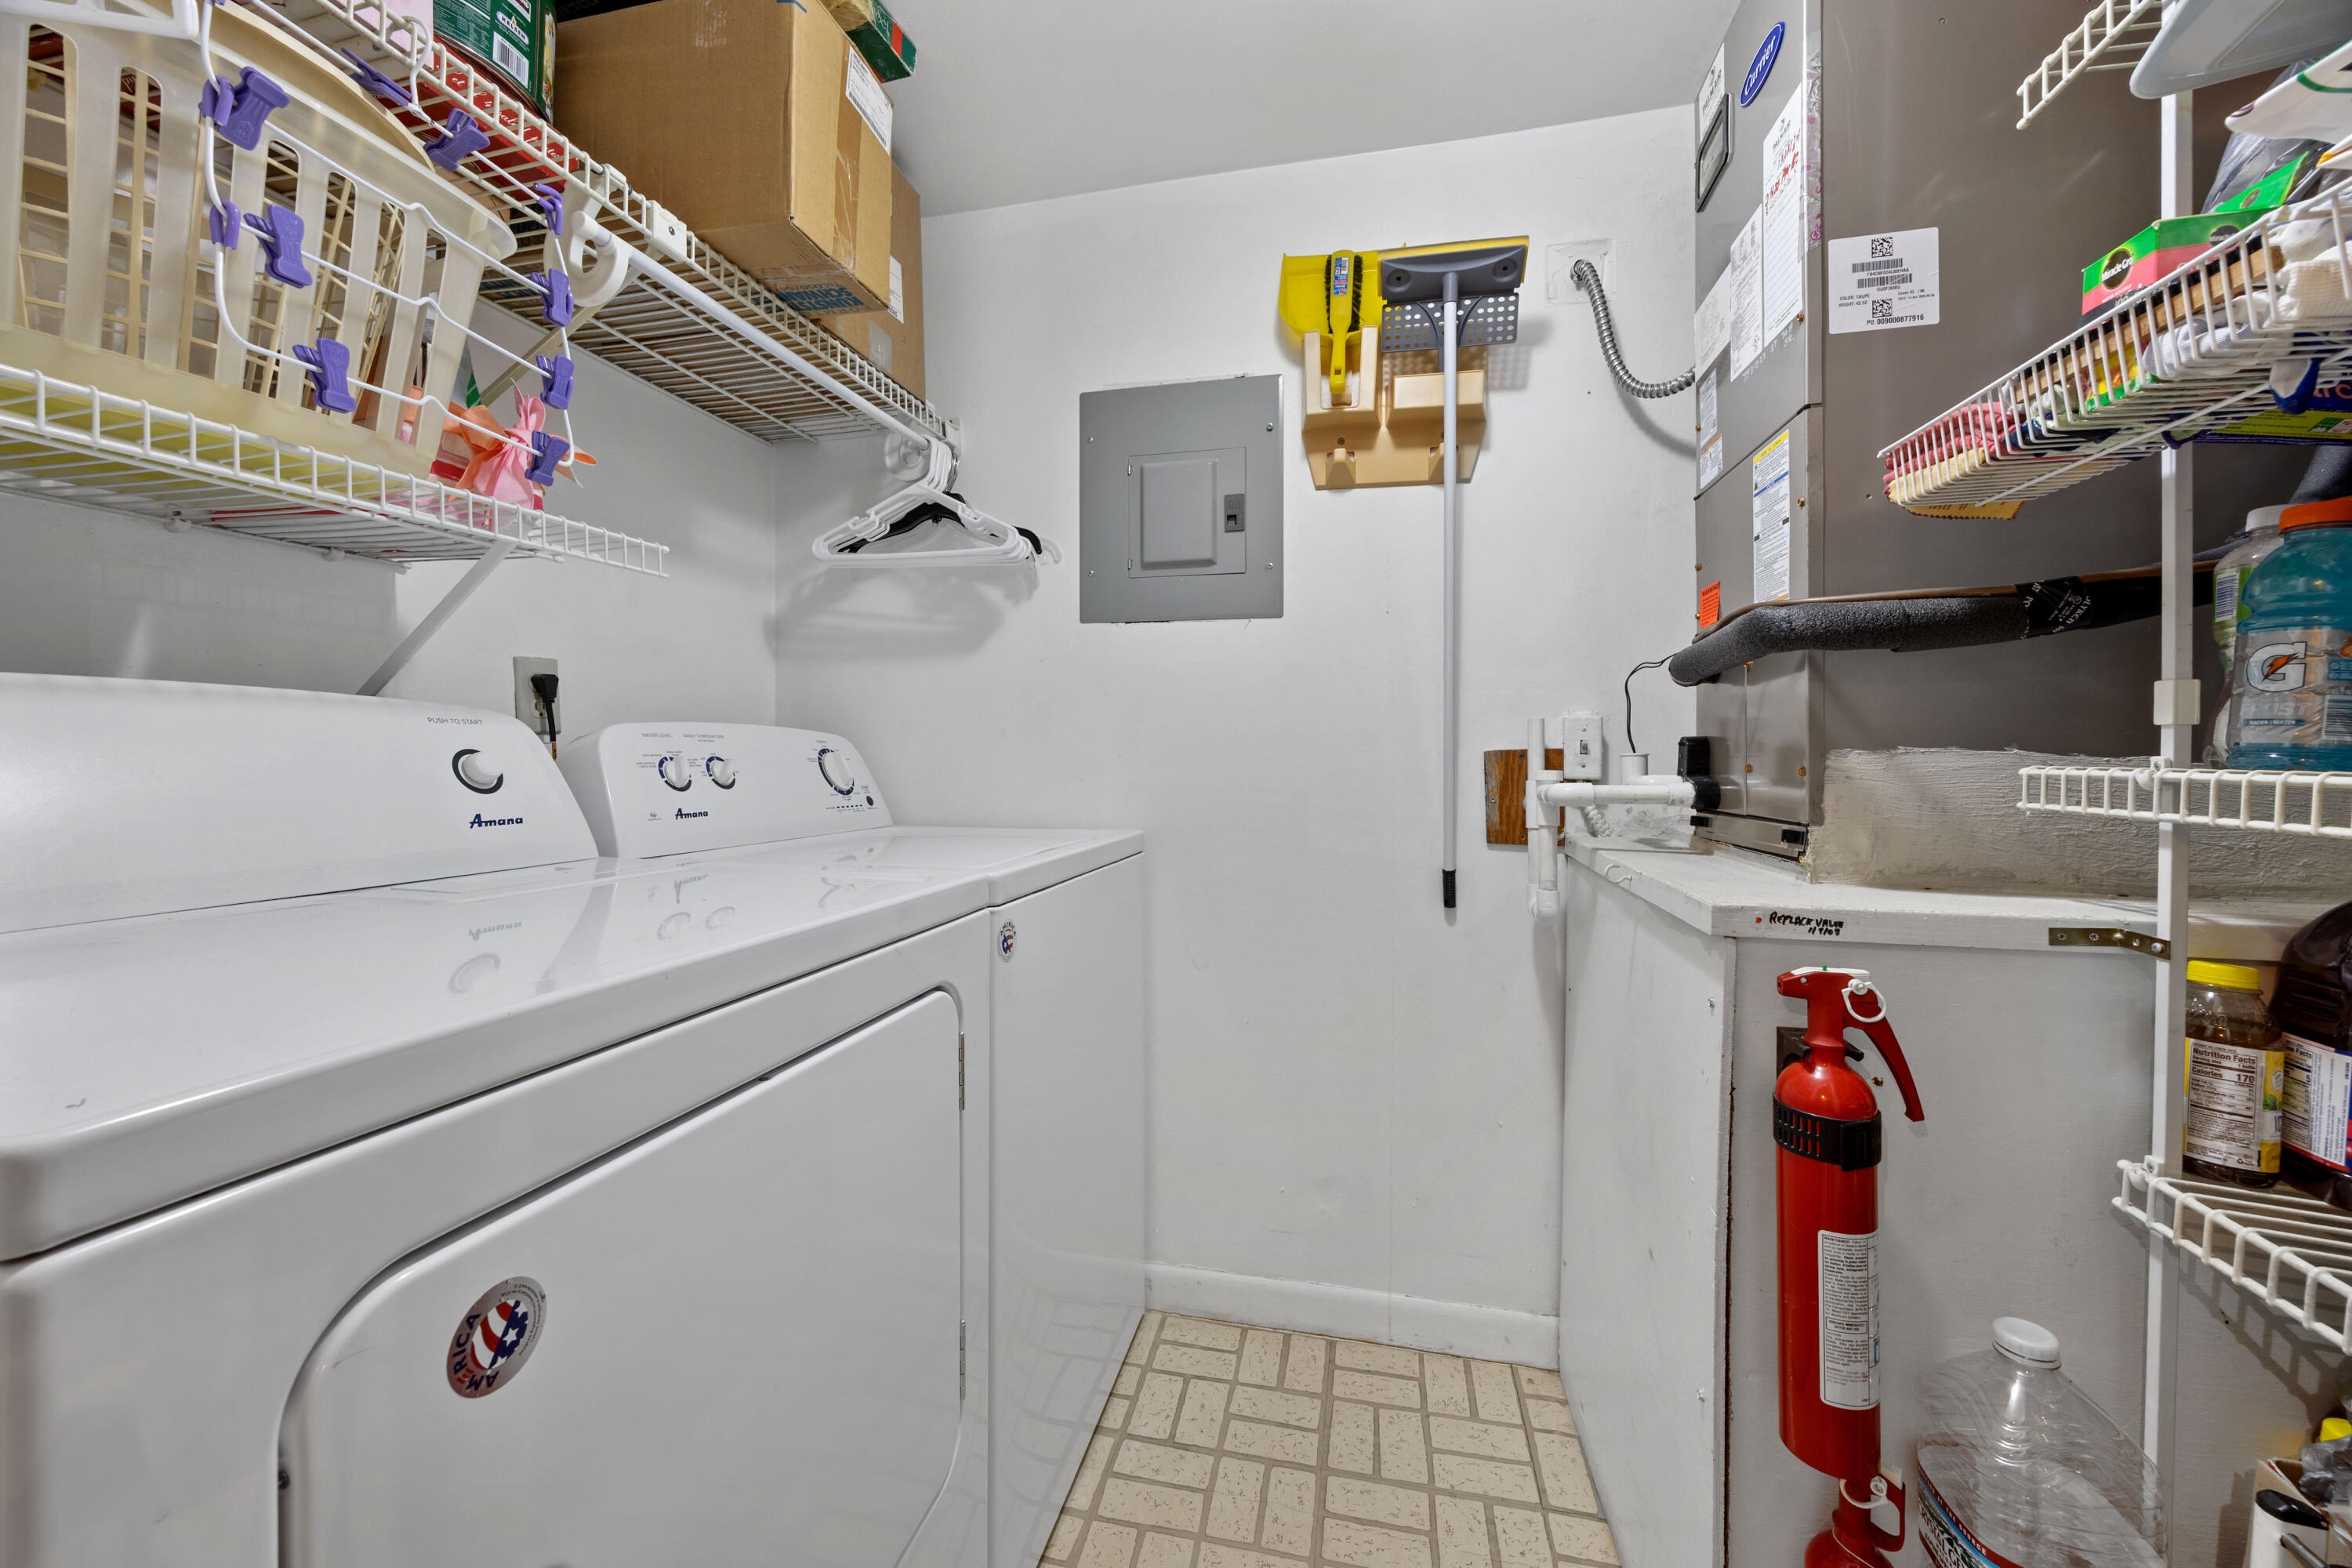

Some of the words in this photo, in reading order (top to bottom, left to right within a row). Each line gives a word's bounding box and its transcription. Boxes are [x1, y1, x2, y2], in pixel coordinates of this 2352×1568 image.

[501, 15, 526, 41] KELSEN
[1744, 34, 1776, 96] Carrier
[2101, 256, 2134, 282] Miracle-Gro
[1877, 314, 1925, 325] 009000877916
[2246, 641, 2307, 692] G
[470, 813, 524, 829] Amana
[675, 808, 709, 820] Amana
[1769, 911, 1813, 926] REPLACE
[2192, 1047, 2231, 1061] Nutrition
[2233, 1055, 2256, 1065] Facts
[2296, 1047, 2312, 1058] Facts
[2191, 1067, 2223, 1079] Calories
[2236, 1073, 2255, 1083] 170
[1945, 1508, 1957, 1522] THE
[1958, 1524, 1987, 1556] SOURCE
